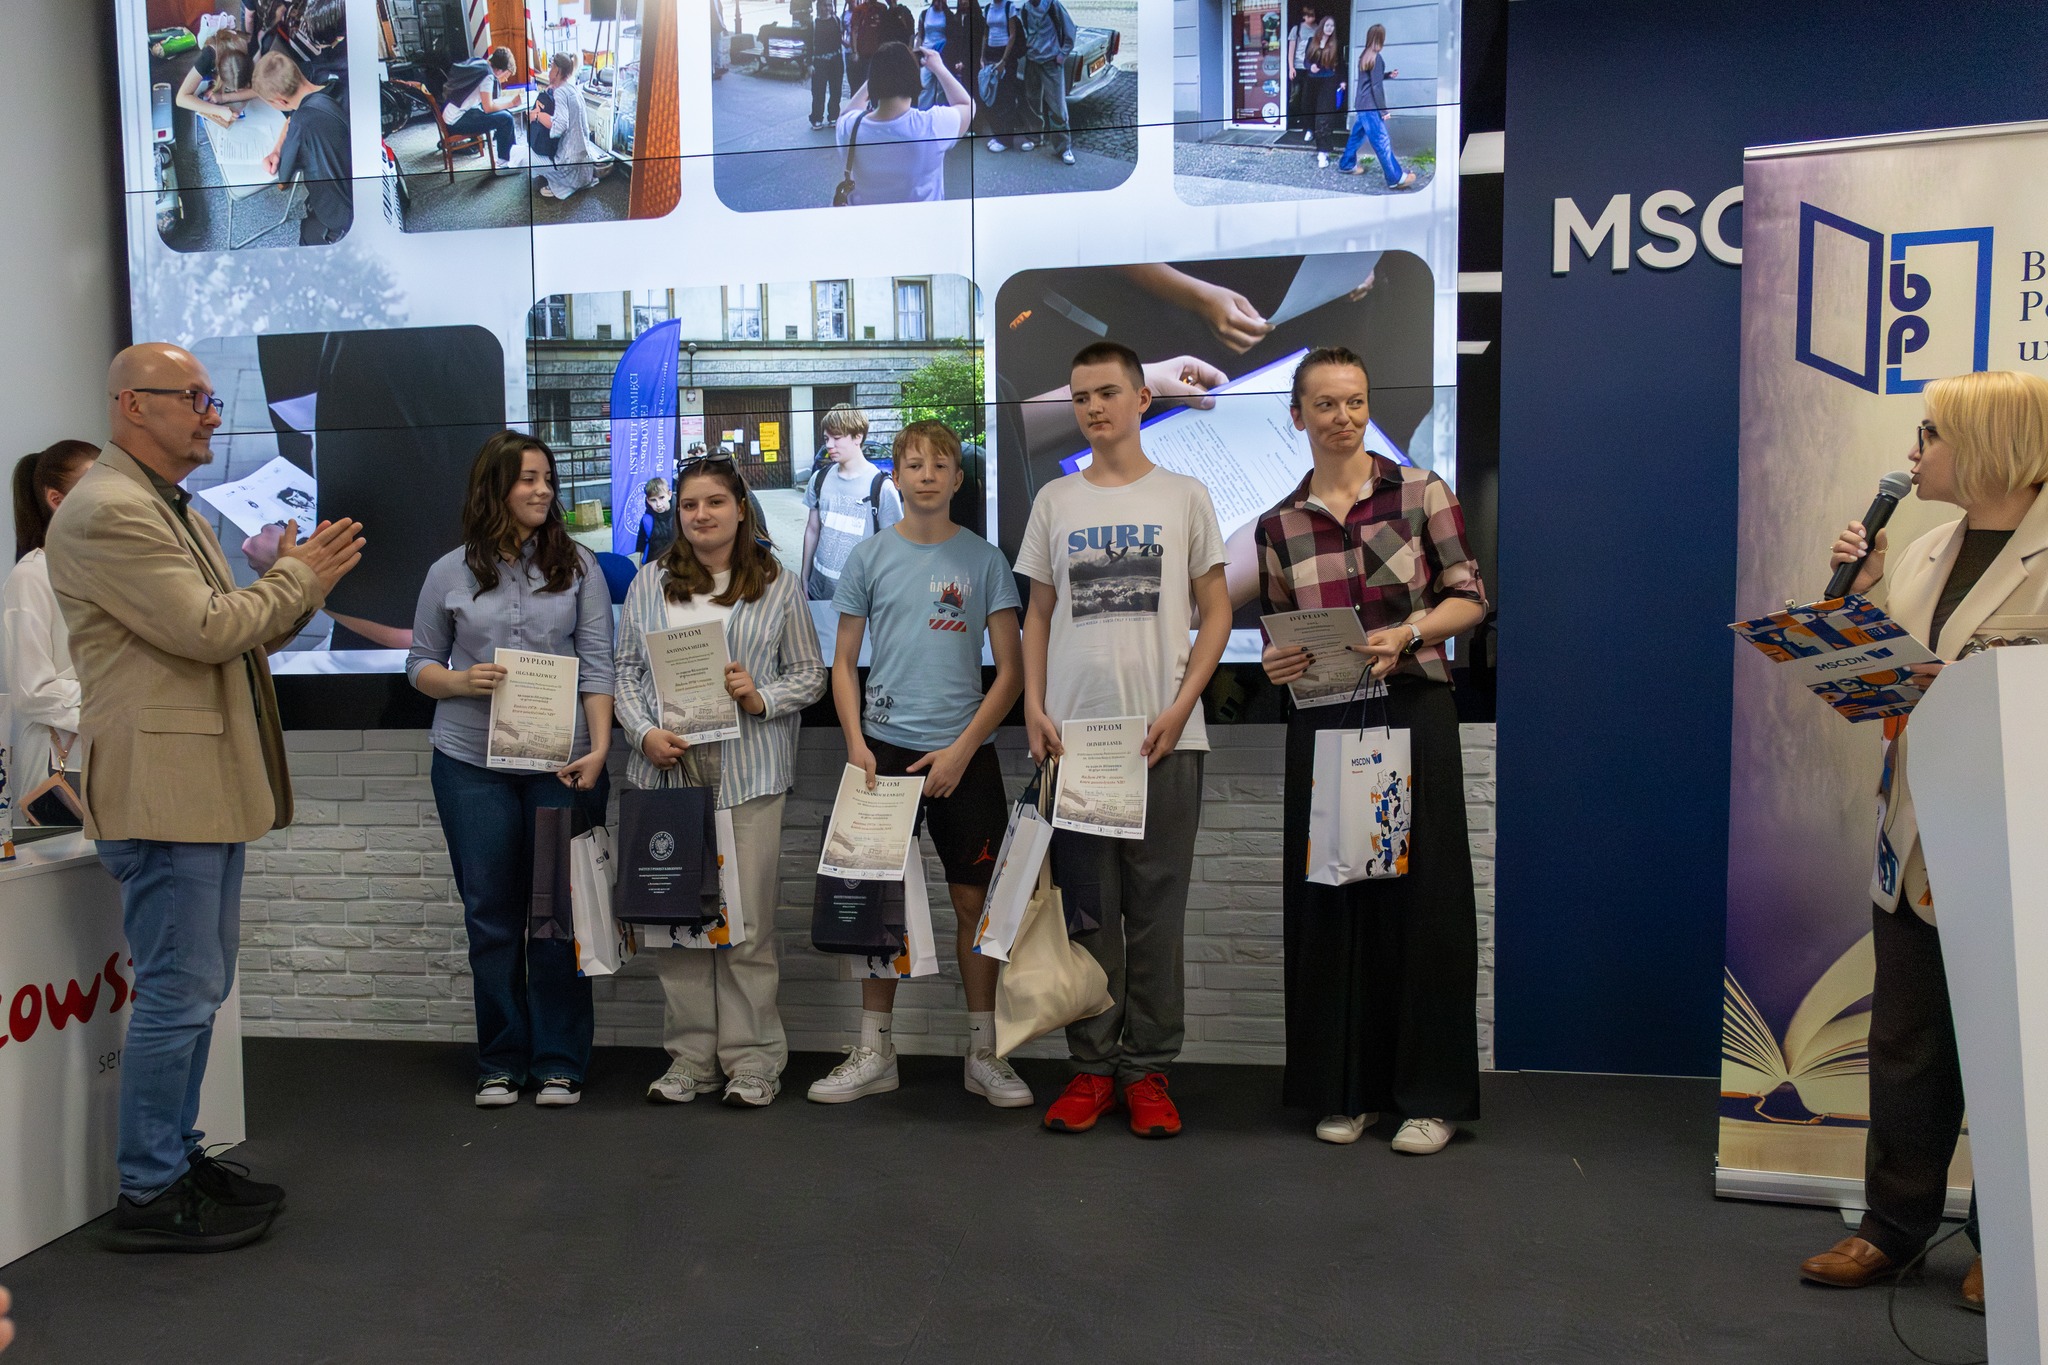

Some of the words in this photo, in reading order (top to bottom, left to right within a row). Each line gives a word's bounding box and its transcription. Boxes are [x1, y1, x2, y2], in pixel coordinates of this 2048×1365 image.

[2019, 290, 2048, 322] P
[629, 421, 639, 475] INSTYTUT
[1068, 523, 1163, 555] SURF
[1139, 543, 1164, 557] 79
[1289, 612, 1329, 622] DYPLOM
[667, 629, 702, 641] DYPLOM
[519, 656, 555, 667] DYPLOM
[1815, 655, 1869, 671] MSCDN
[1086, 723, 1122, 732] DYPLOM
[1351, 757, 1371, 767] MSCDN
